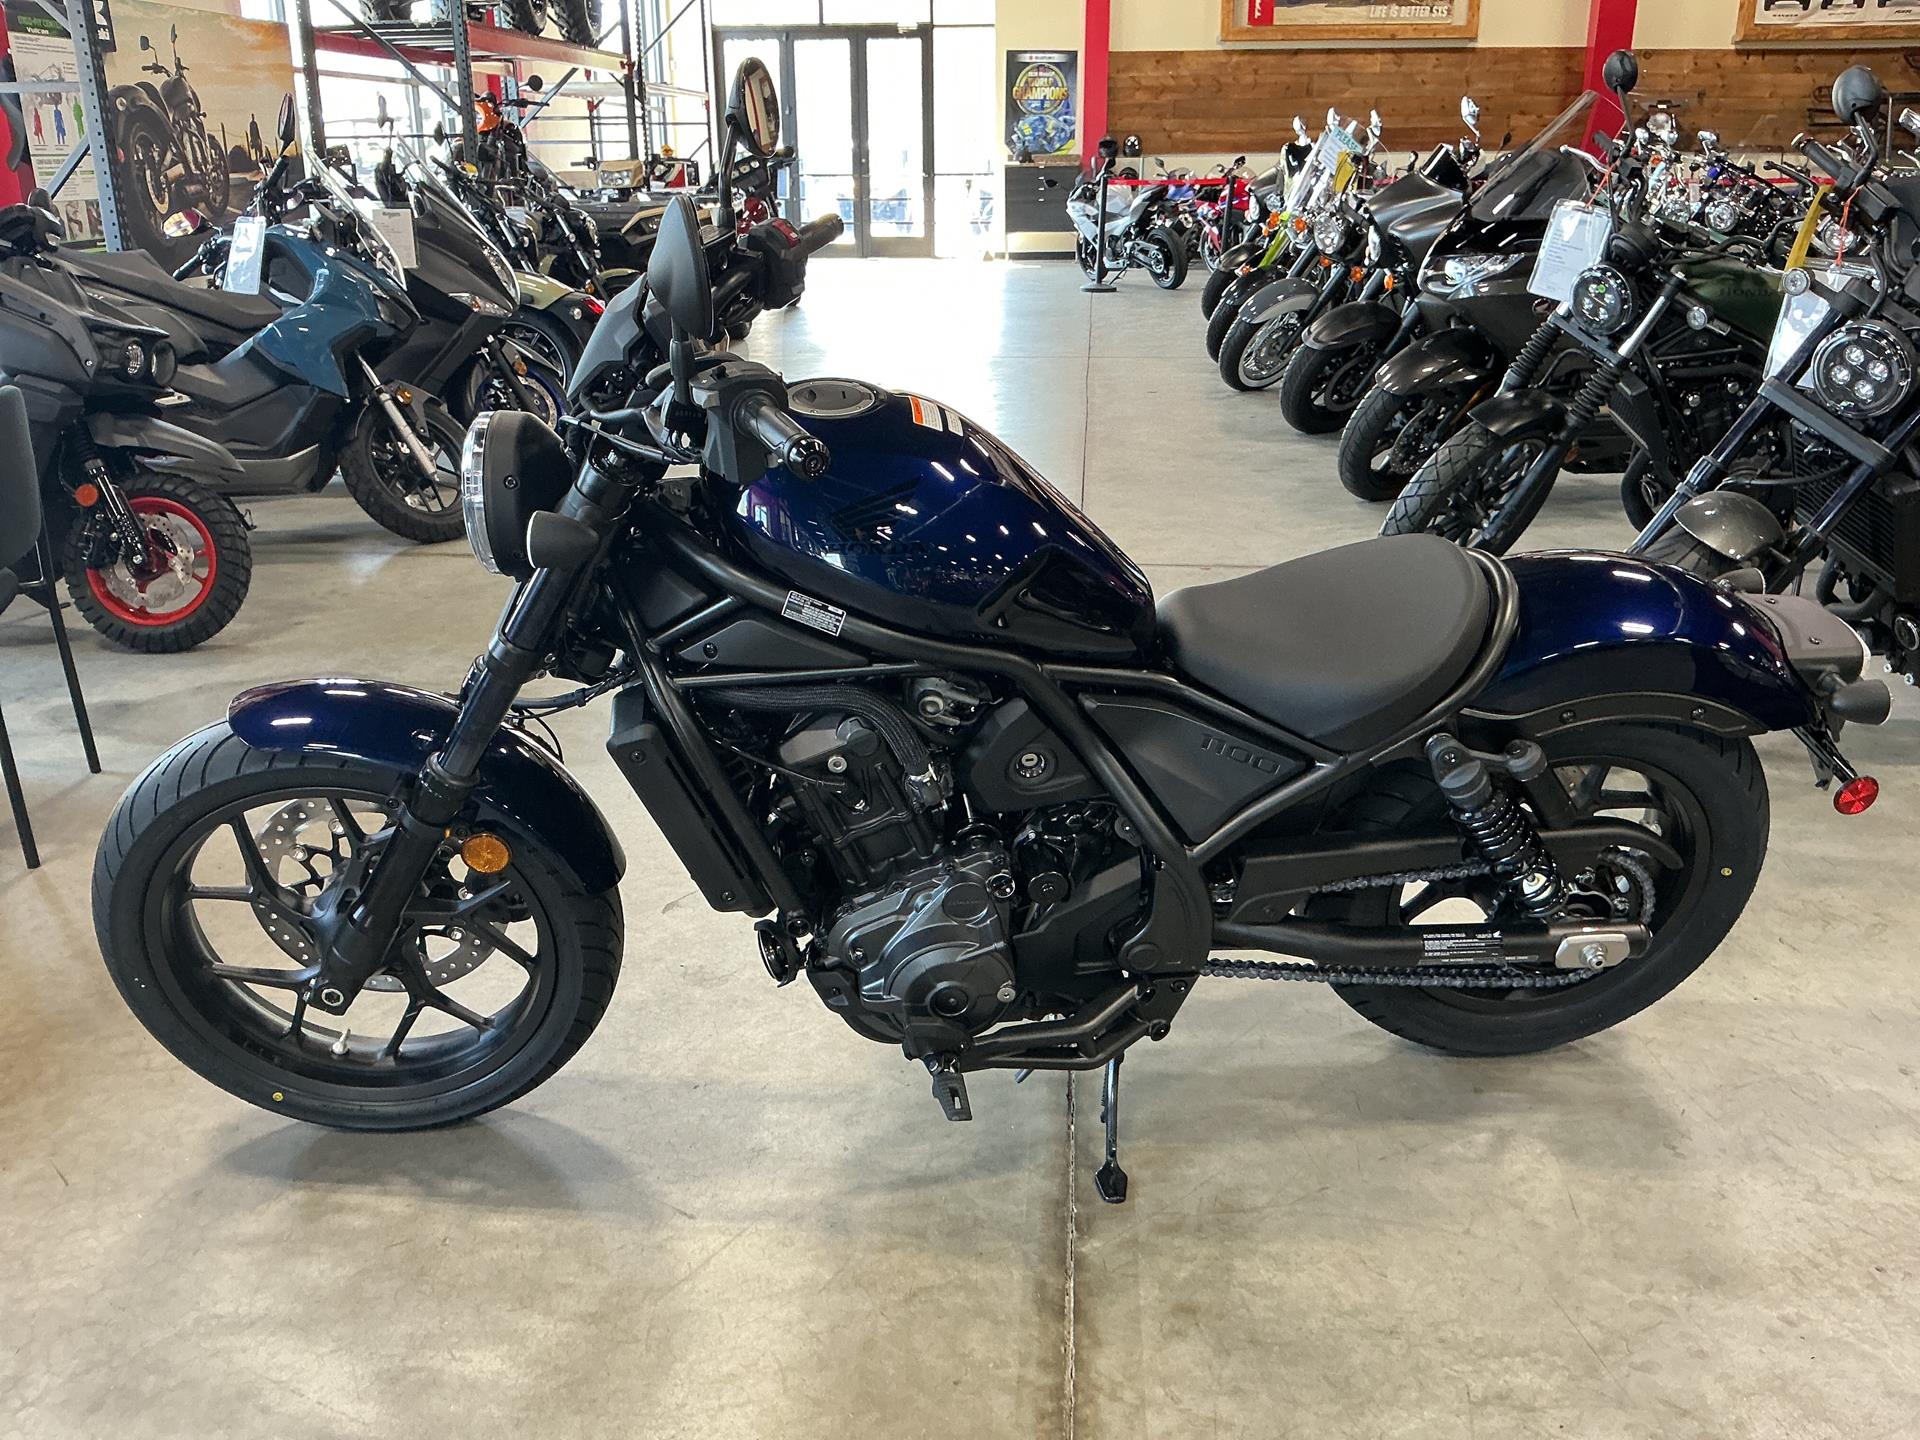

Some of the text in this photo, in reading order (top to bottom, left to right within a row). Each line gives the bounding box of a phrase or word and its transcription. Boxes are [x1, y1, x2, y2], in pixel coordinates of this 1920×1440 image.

[1369, 5, 1388, 18] LIFE
[1389, 5, 1399, 18] IS
[1400, 5, 1431, 18] BETTER
[26, 26, 50, 36] Vulcan
[1012, 86, 1069, 100] CHAMPIONS
[1200, 734, 1281, 775] 1100
